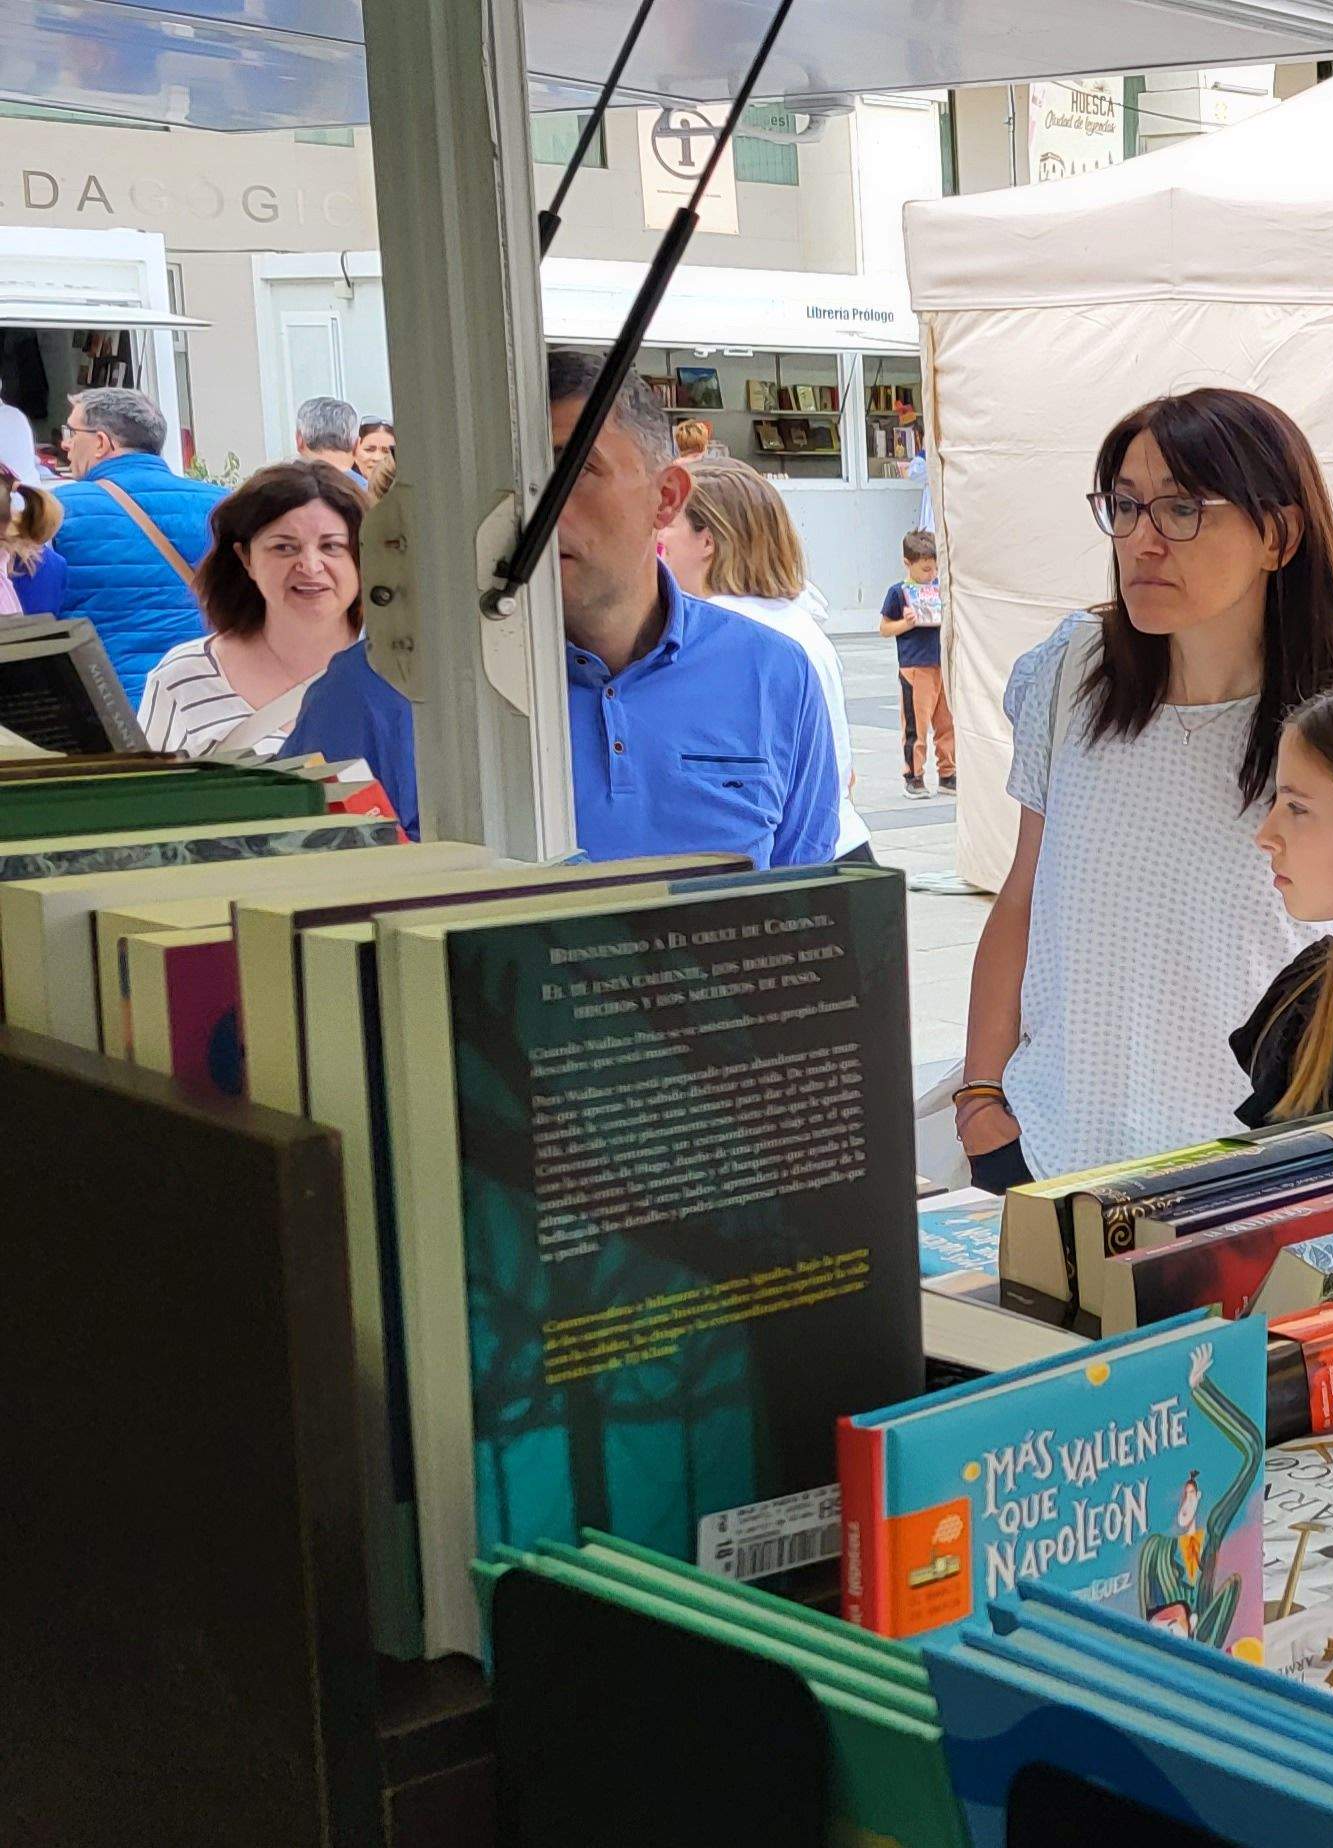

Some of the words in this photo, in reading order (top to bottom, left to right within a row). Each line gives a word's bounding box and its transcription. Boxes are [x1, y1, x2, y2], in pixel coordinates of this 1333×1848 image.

[1045, 111, 1073, 129] Ciudad
[1073, 113, 1084, 129] de
[1071, 91, 1115, 118] HUESCA
[807, 305, 849, 320] Librería
[852, 308, 894, 323] Prólogo
[981, 1429, 1057, 1518] MÁS
[1058, 1396, 1189, 1489] VALIENTE
[998, 1487, 1059, 1536] QUE
[986, 1478, 1150, 1598] NAPOLEÓN
